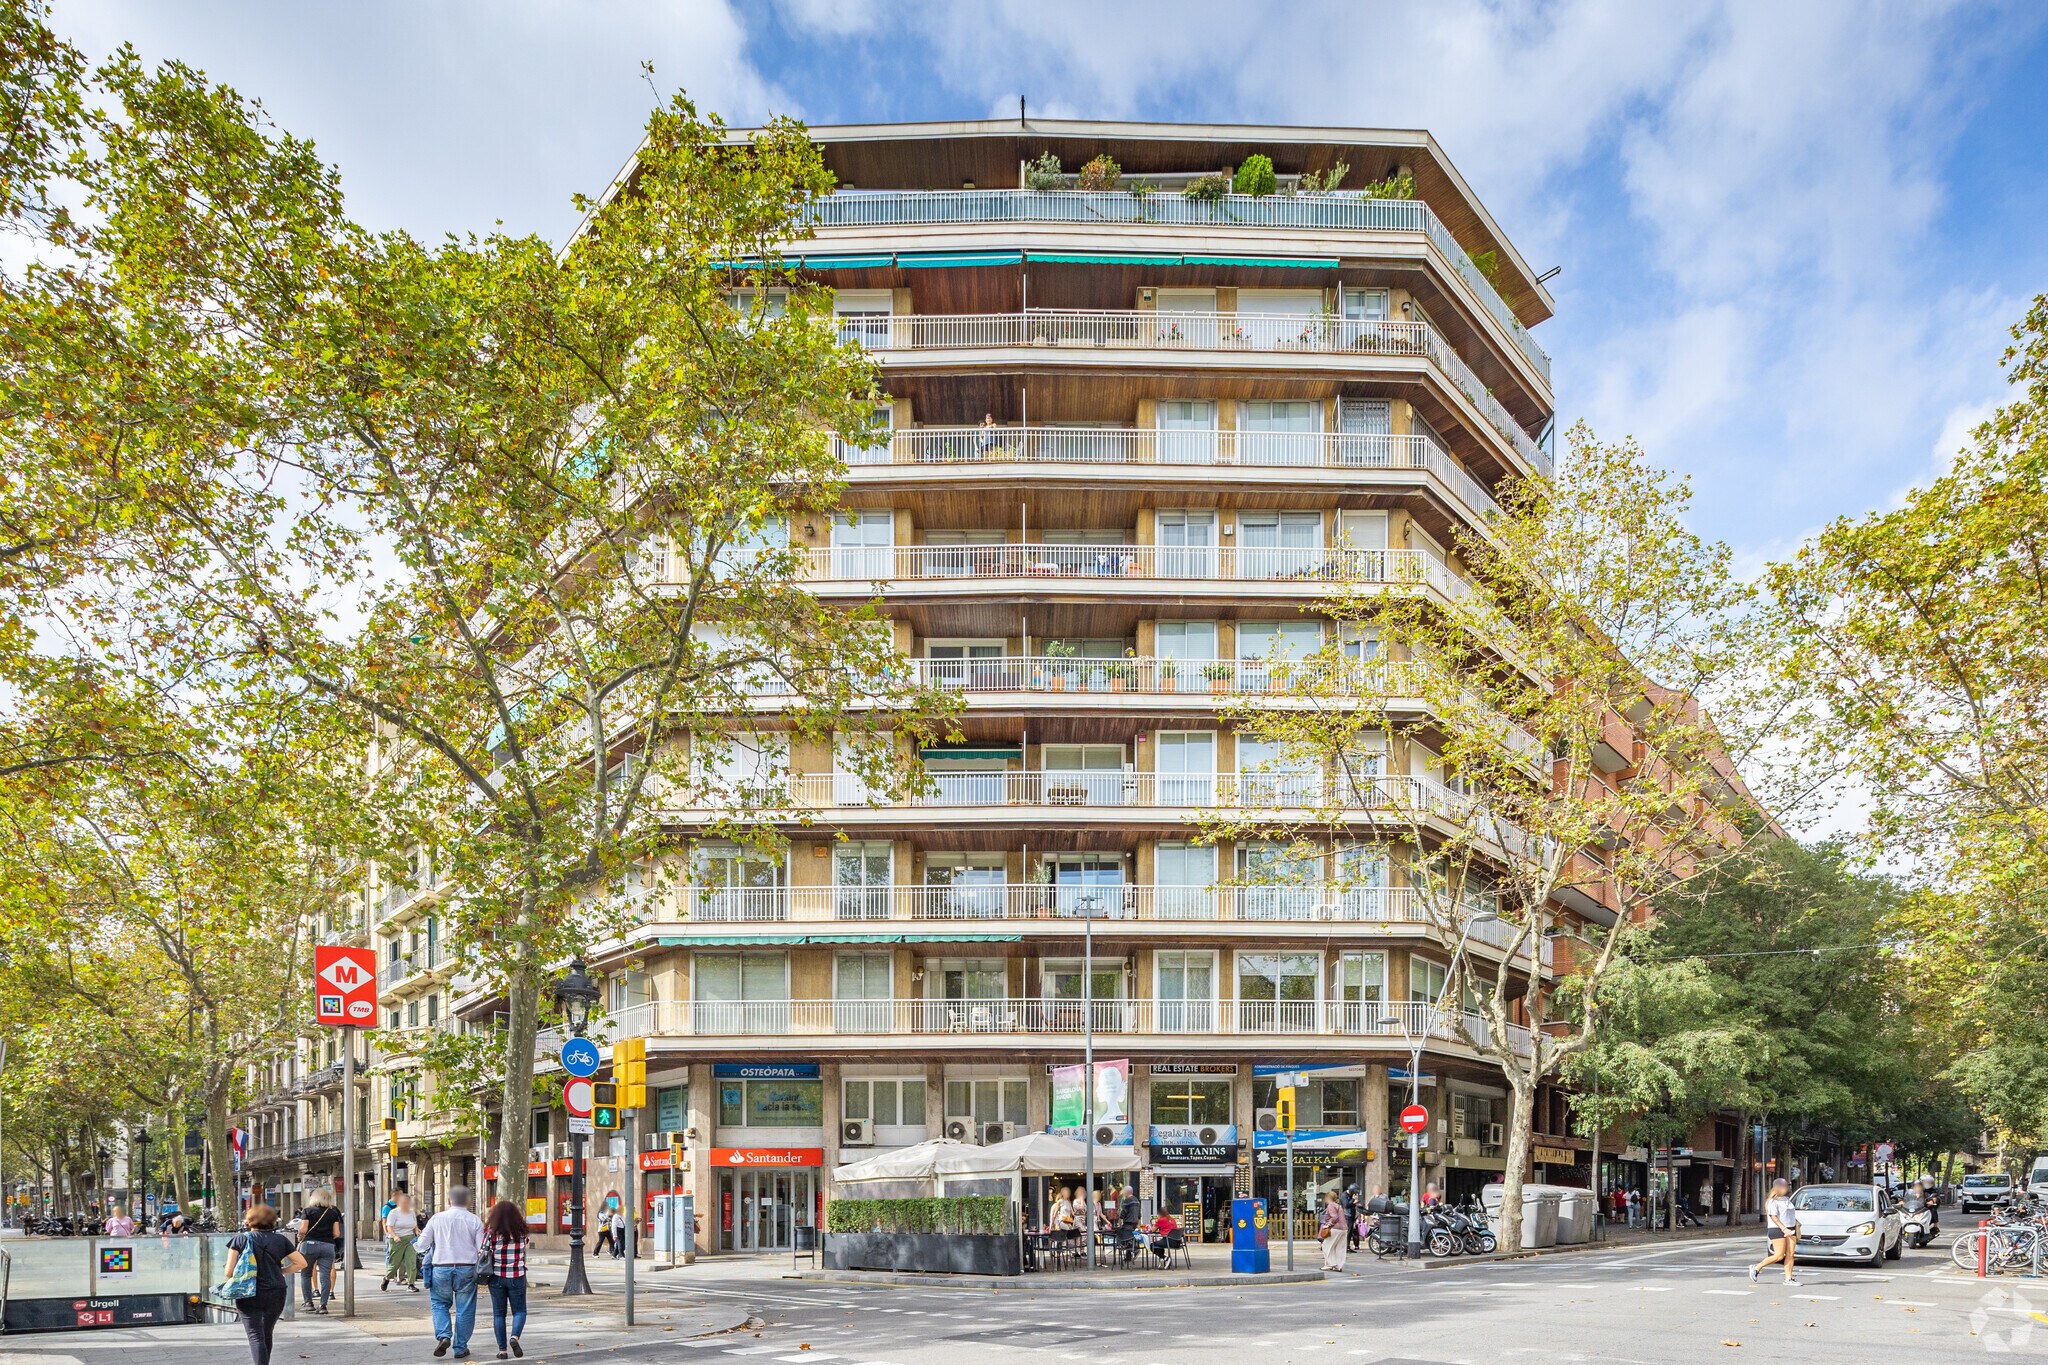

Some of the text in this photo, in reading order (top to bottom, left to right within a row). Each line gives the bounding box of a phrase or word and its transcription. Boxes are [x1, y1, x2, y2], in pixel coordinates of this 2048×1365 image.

[336, 966, 357, 984] M
[740, 1065, 795, 1077] OSTEÒPATA
[1200, 1065, 1234, 1073] BROKERS
[1162, 1147, 1226, 1155] BAR TANINS
[746, 1152, 803, 1163] Santander
[90, 1300, 119, 1308] Urgell
[99, 1313, 111, 1322] L1
